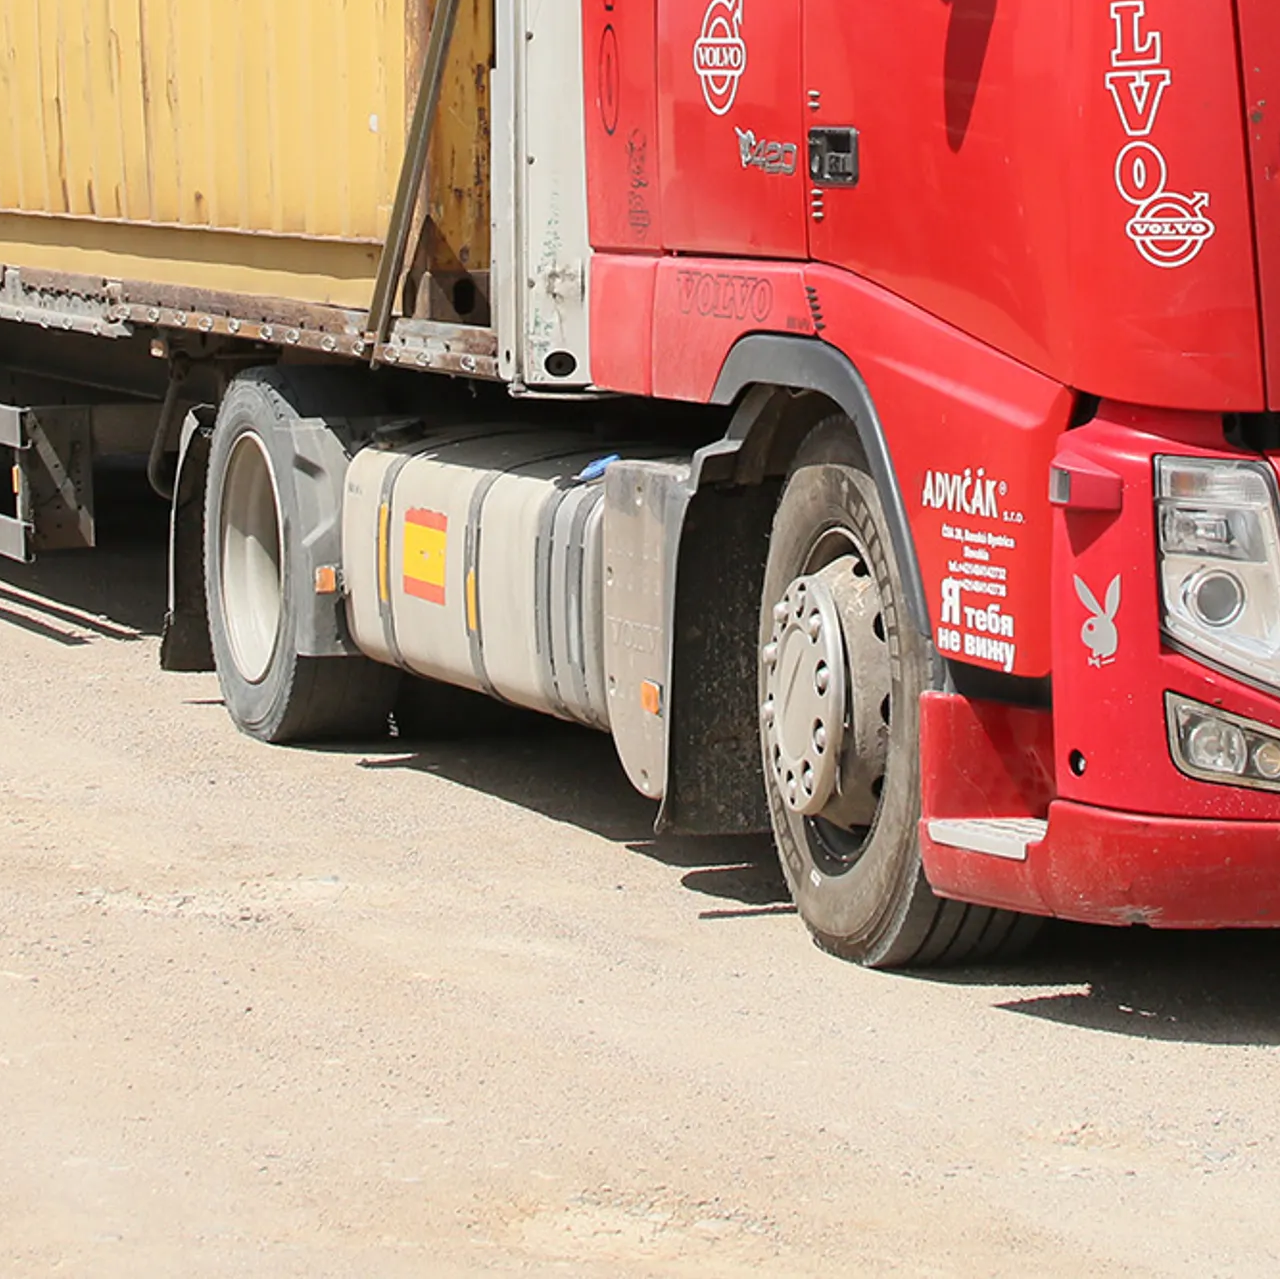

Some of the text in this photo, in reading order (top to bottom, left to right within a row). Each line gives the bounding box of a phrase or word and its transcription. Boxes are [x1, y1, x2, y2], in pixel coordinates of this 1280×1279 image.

[697, 46, 742, 68] VOLVO
[751, 138, 798, 176] 420
[1132, 222, 1206, 235] VOLVO
[677, 270, 774, 323] VOLVO
[940, 578, 961, 626] Я
[963, 603, 1015, 638] тебя
[937, 626, 1016, 673] не вижу
